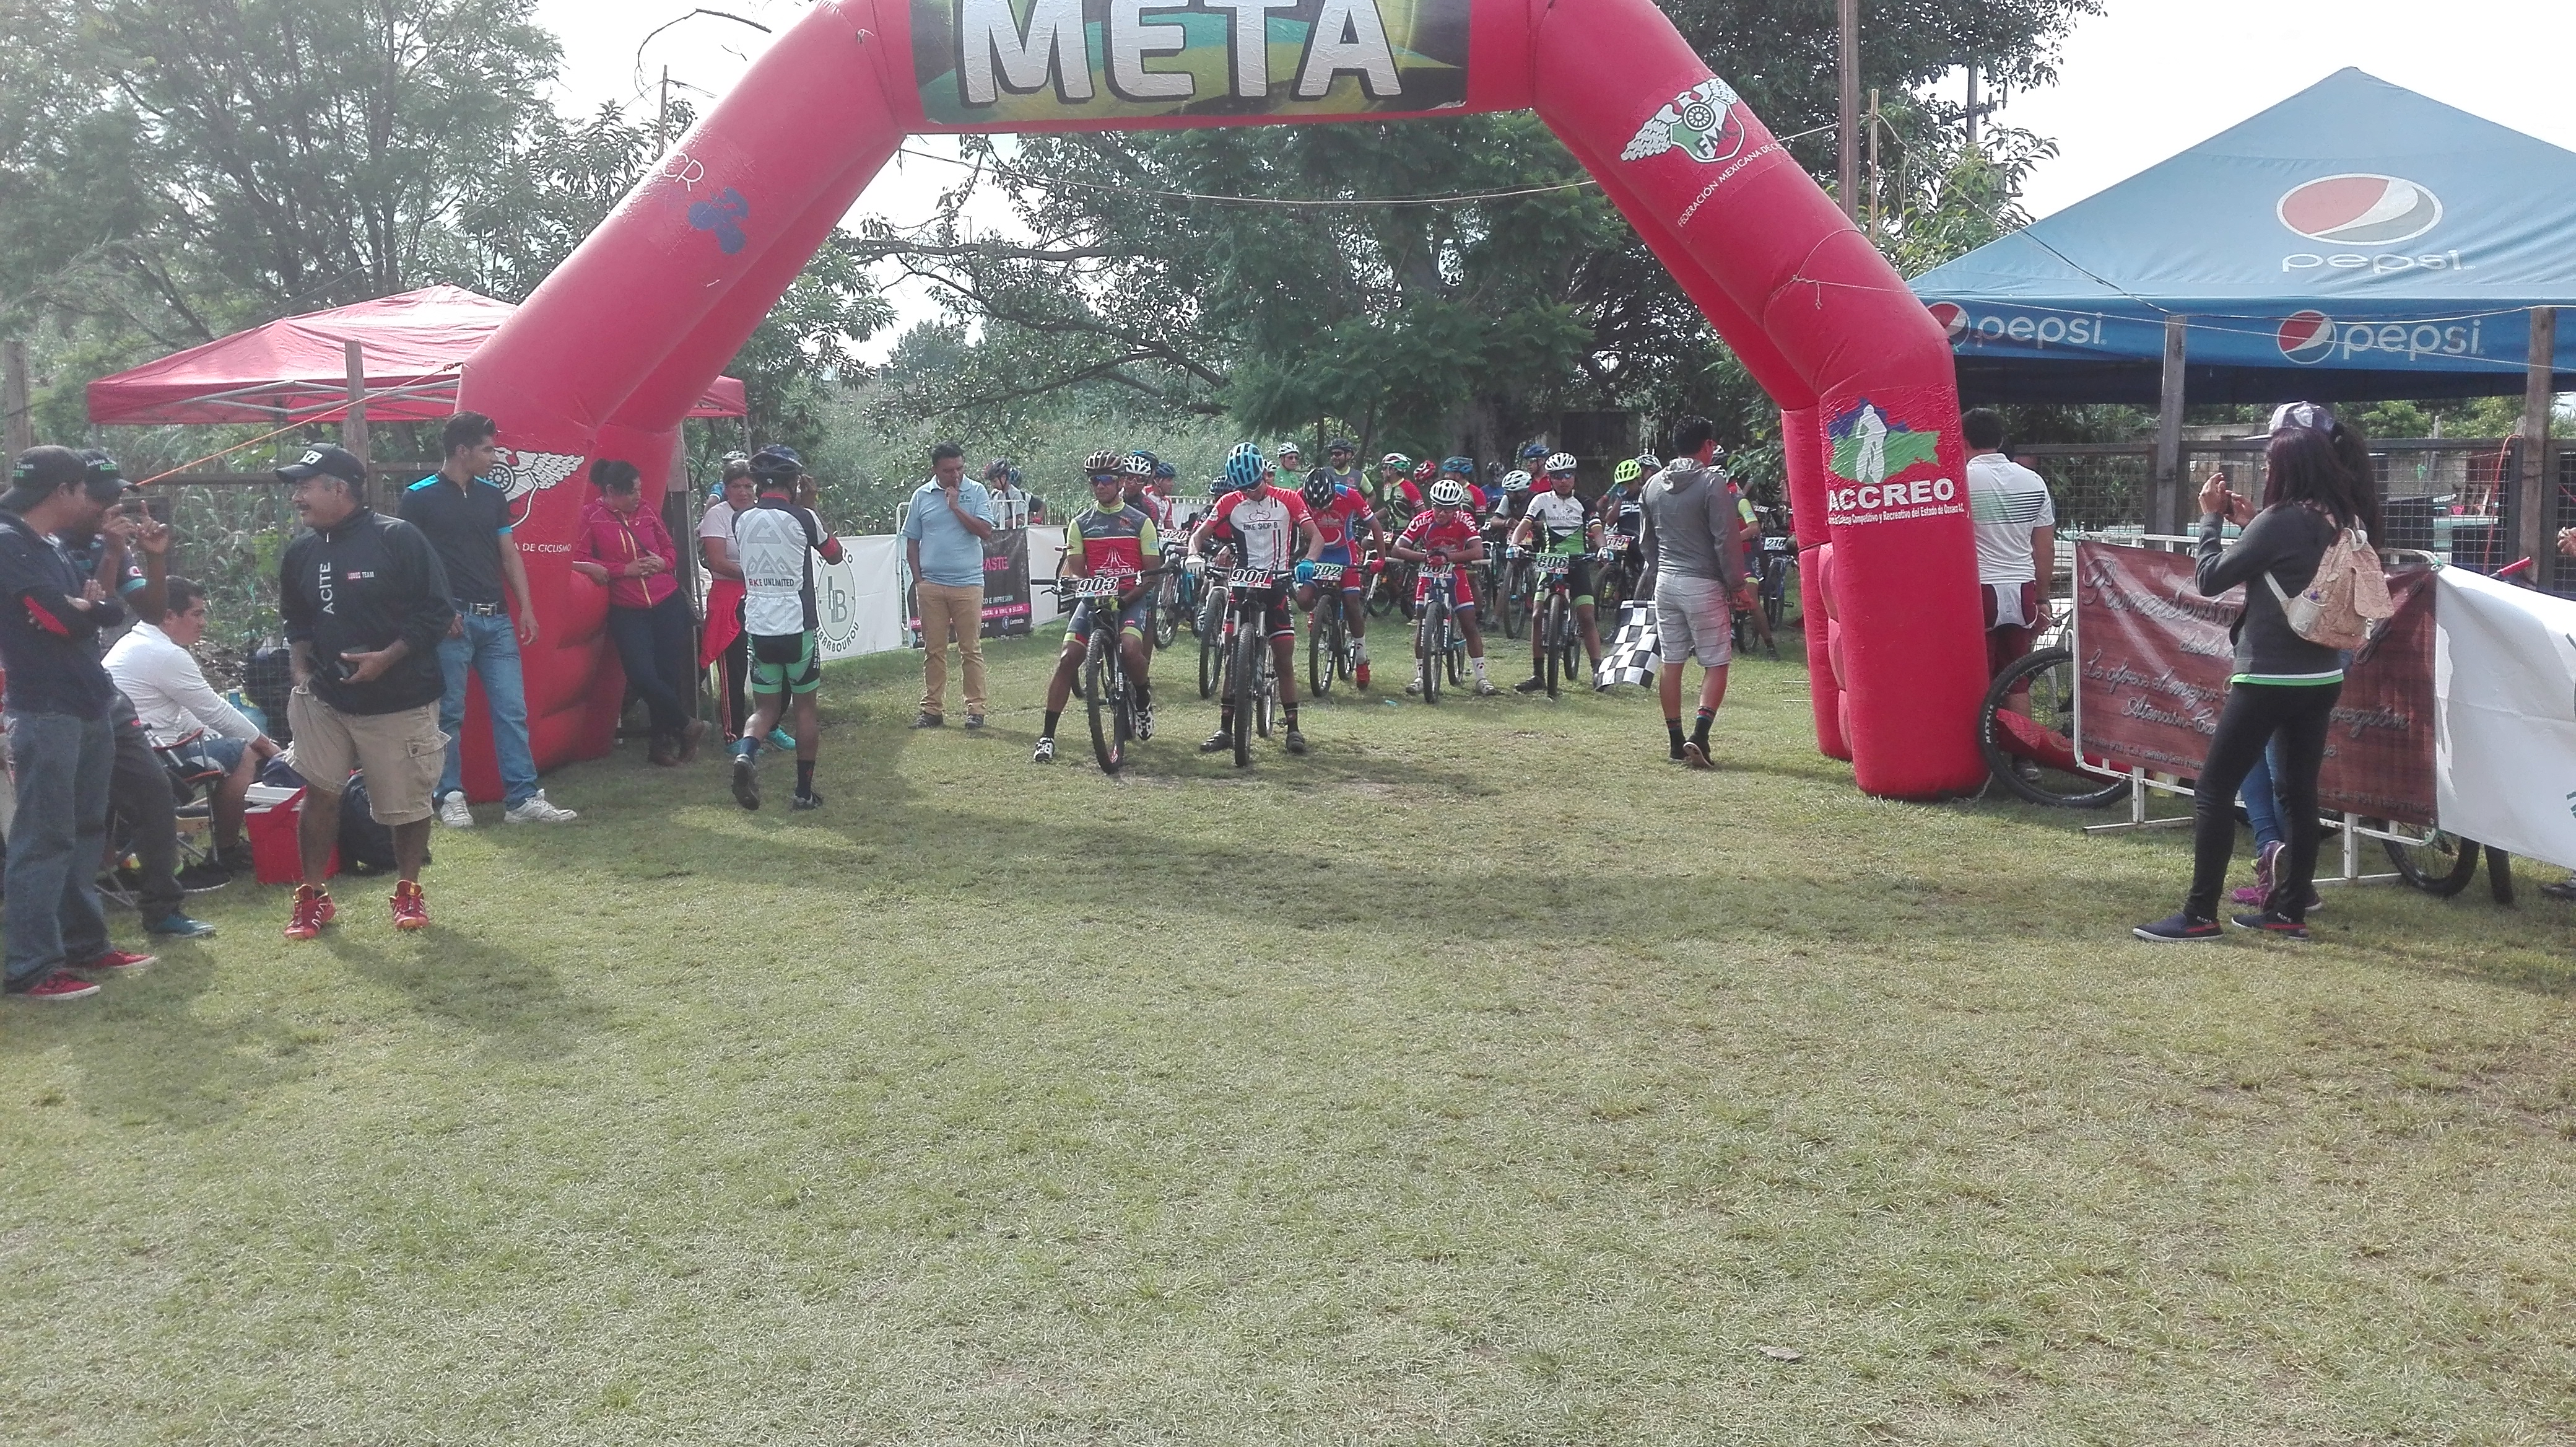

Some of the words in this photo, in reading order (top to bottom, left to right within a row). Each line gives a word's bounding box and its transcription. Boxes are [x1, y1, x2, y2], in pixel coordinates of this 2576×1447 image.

[960, 0, 1403, 104] META
[1677, 181, 1718, 227] FEDERACIÓN
[1718, 150, 1762, 183] MEXICANA
[1760, 144, 1772, 154] DE
[2282, 250, 2461, 274] pepsi
[1977, 312, 2102, 349] pepsi
[2343, 319, 2481, 361] pepsi
[1829, 478, 1955, 512] ACCREO
[1878, 514, 1882, 524] y
[1882, 510, 1911, 522] Recreativo
[1912, 507, 1920, 517] del
[1920, 505, 1938, 517] Estado
[1938, 505, 1944, 514] de
[1163, 530, 1188, 540] 320
[522, 543, 535, 551] DE
[538, 543, 572, 553] CICLISMO
[1105, 567, 1134, 575] ISSAN
[1537, 555, 1569, 569] 806
[1077, 577, 1119, 593] 903
[1230, 569, 1269, 584] 901
[319, 562, 334, 614] ACITE
